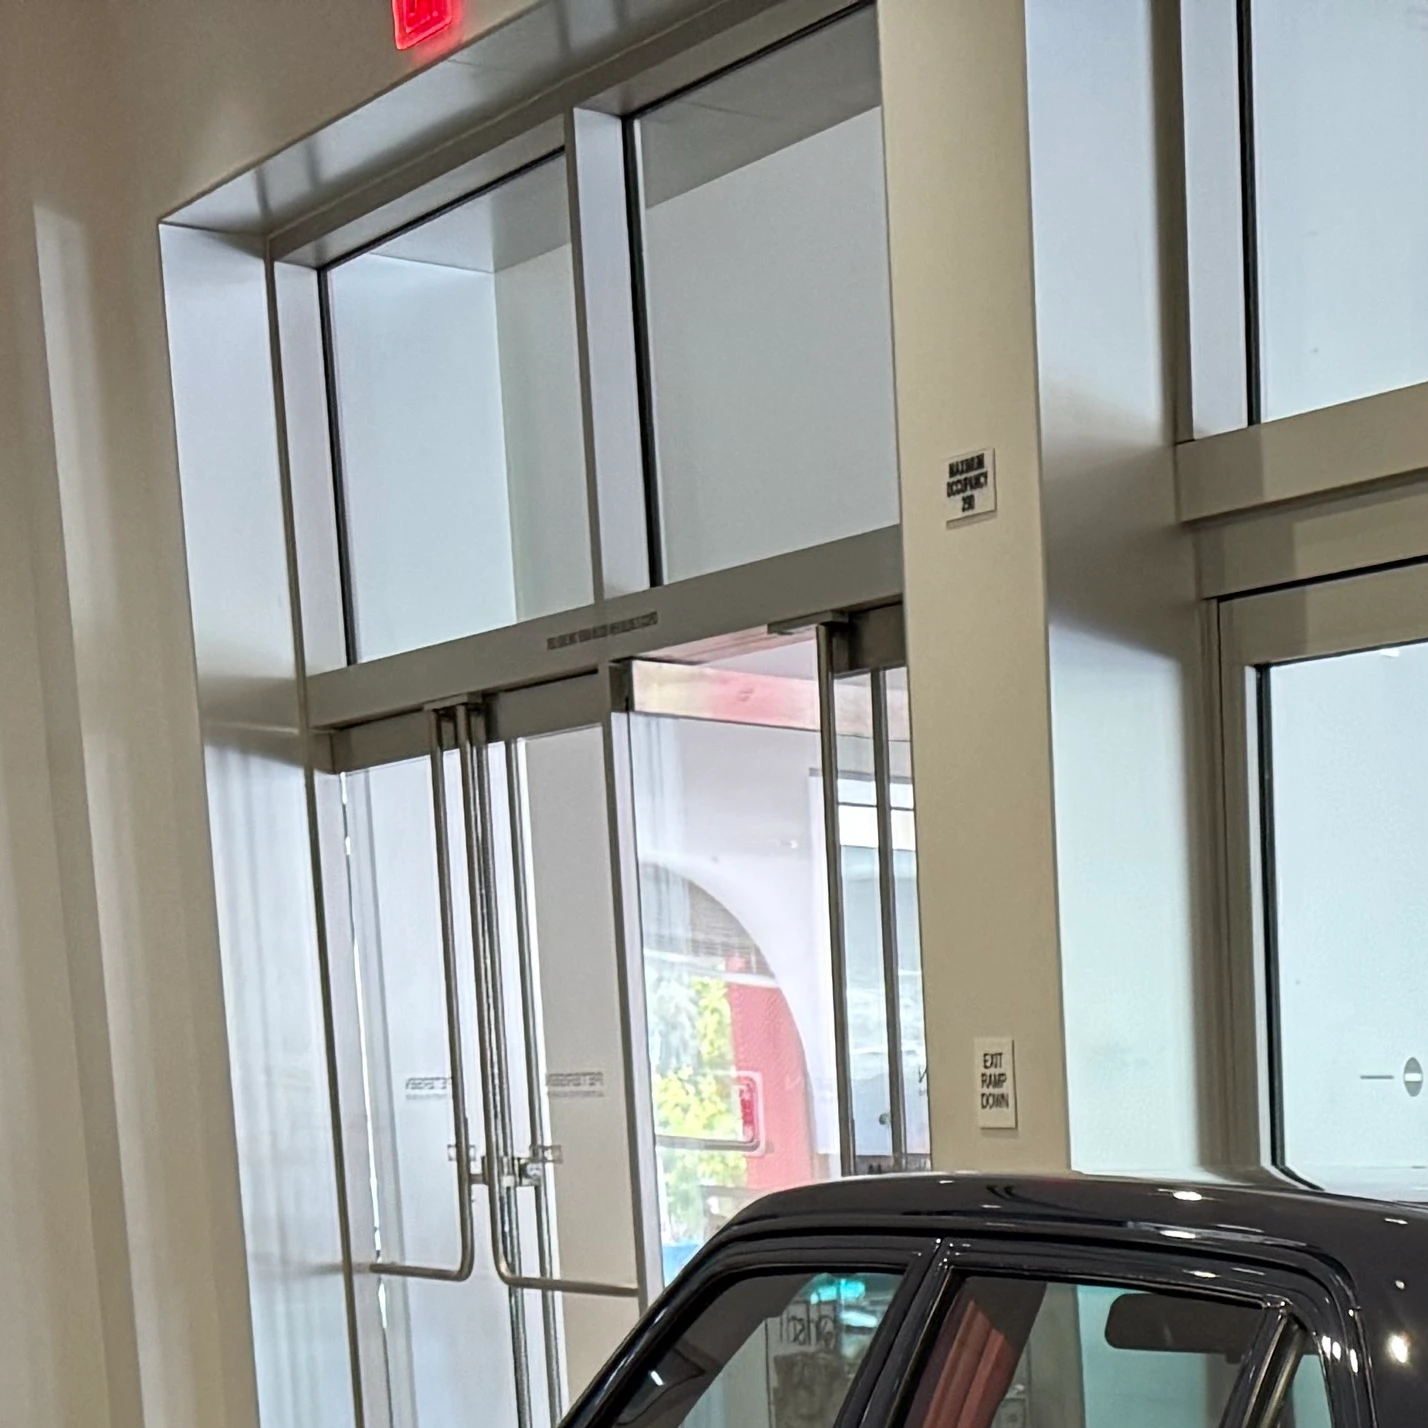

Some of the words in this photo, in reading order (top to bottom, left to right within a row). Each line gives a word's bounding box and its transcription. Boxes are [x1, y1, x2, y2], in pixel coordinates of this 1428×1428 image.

[947, 470, 988, 498] OCCUPANCY
[983, 1052, 1003, 1069] EXIT
[981, 1072, 1007, 1089] RAMP
[981, 1093, 1009, 1110] DOWN
